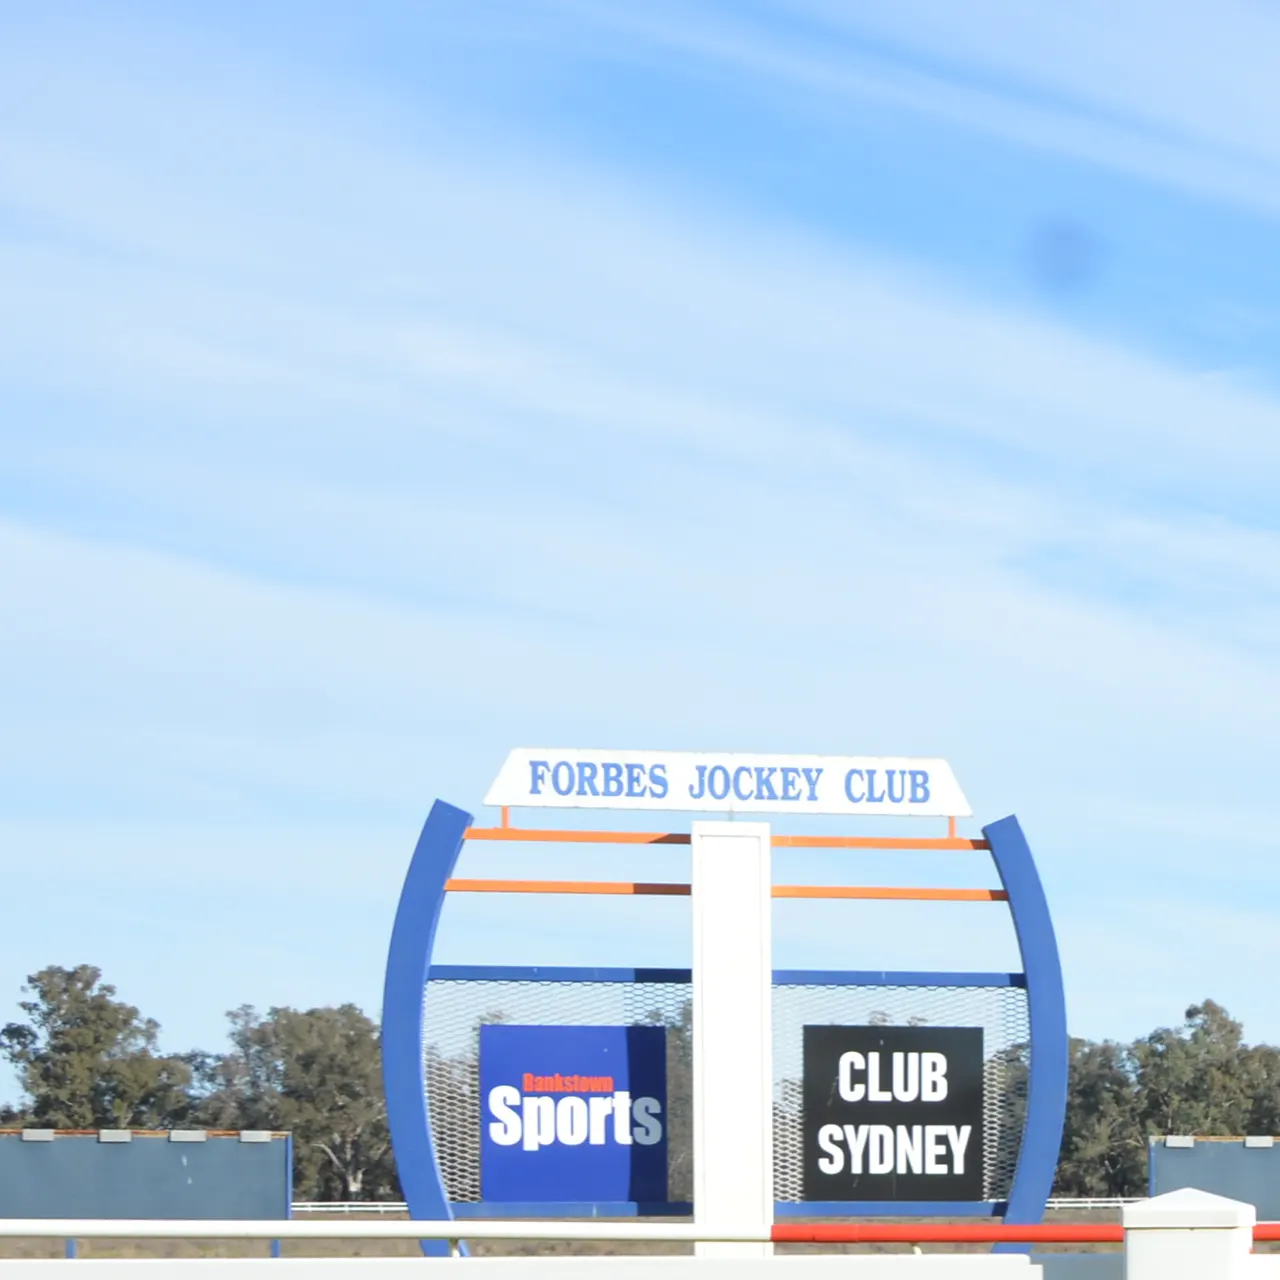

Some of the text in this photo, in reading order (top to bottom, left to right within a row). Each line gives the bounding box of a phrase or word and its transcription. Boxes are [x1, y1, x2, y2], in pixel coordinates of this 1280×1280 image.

[528, 760, 931, 804] FORBES JOCKEY CLUB
[522, 1072, 615, 1093] Bankstown
[838, 1051, 949, 1103] CLUB
[488, 1084, 663, 1152] Sports
[817, 1124, 973, 1175] SYDNEY
